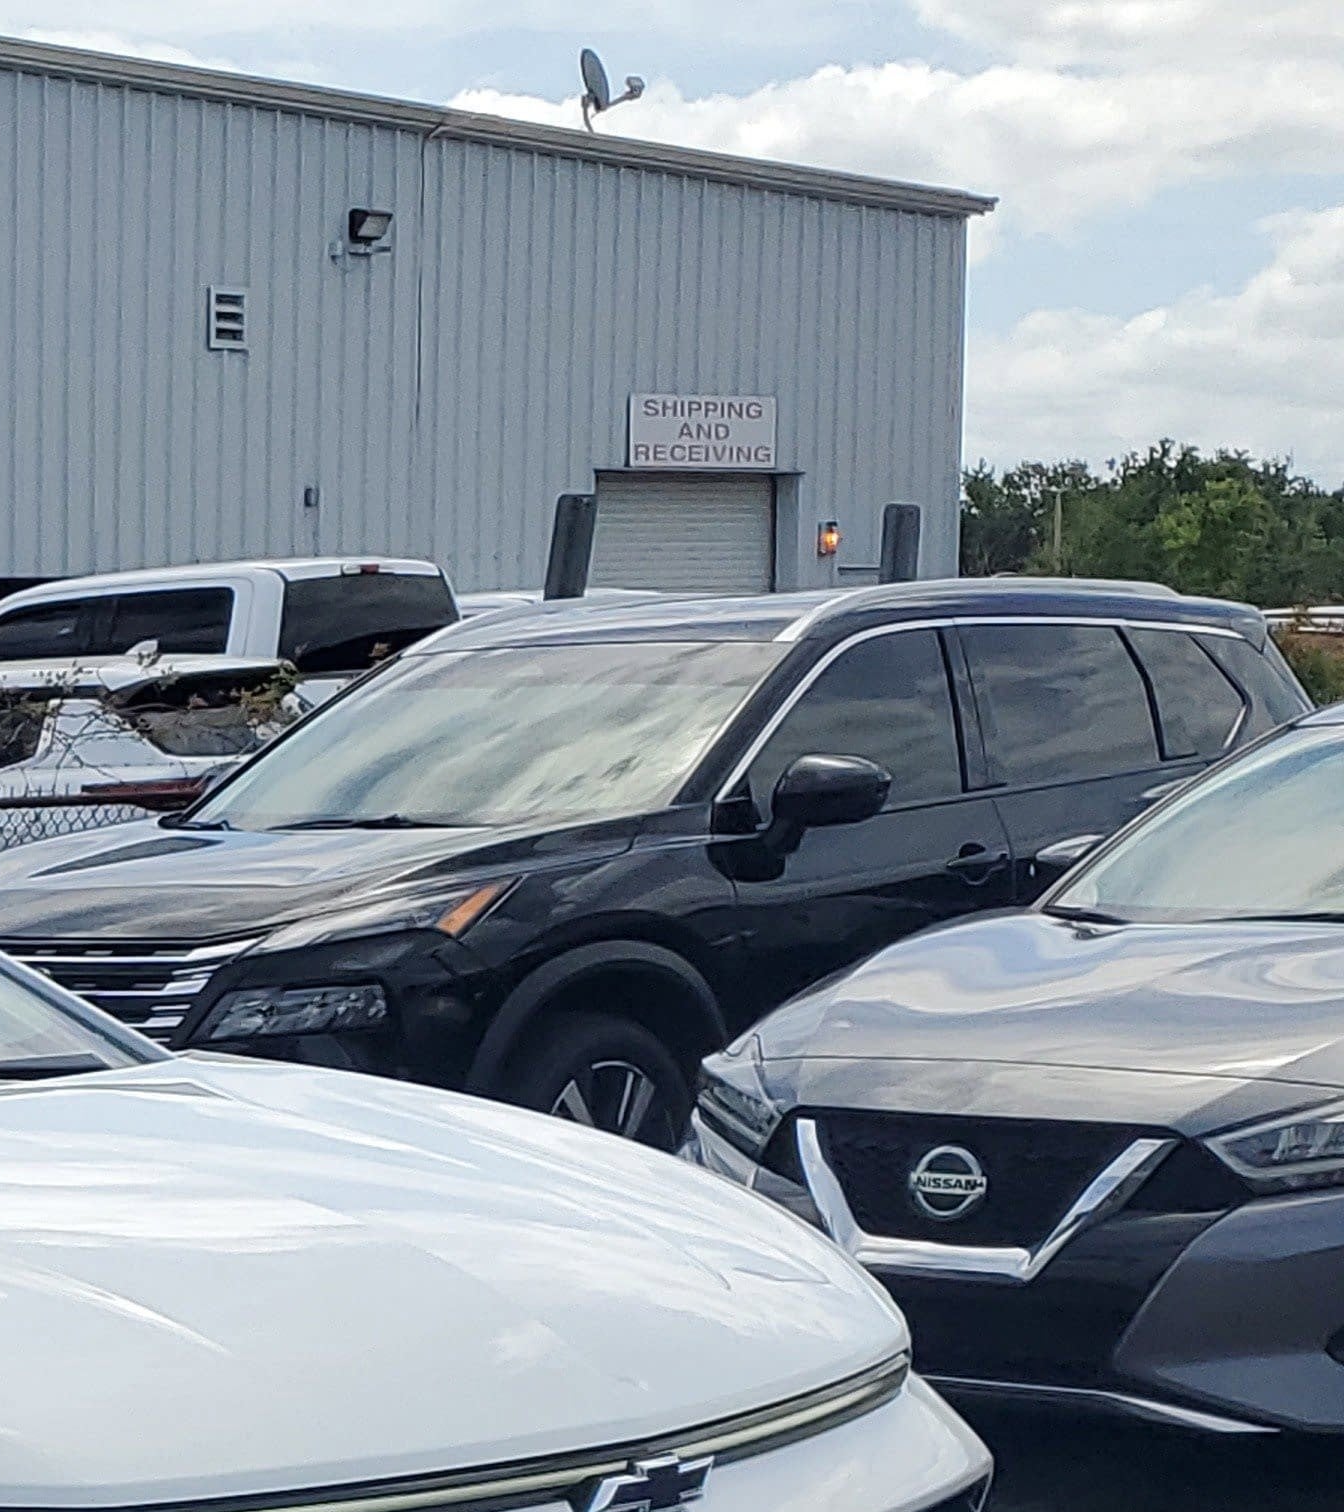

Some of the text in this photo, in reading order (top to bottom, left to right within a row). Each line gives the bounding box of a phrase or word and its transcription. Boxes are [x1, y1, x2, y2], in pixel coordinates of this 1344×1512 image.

[643, 399, 762, 419] SHIPPING
[678, 422, 730, 440] AND
[634, 443, 771, 462] RECEIVING
[917, 1175, 976, 1191] NISSAN
